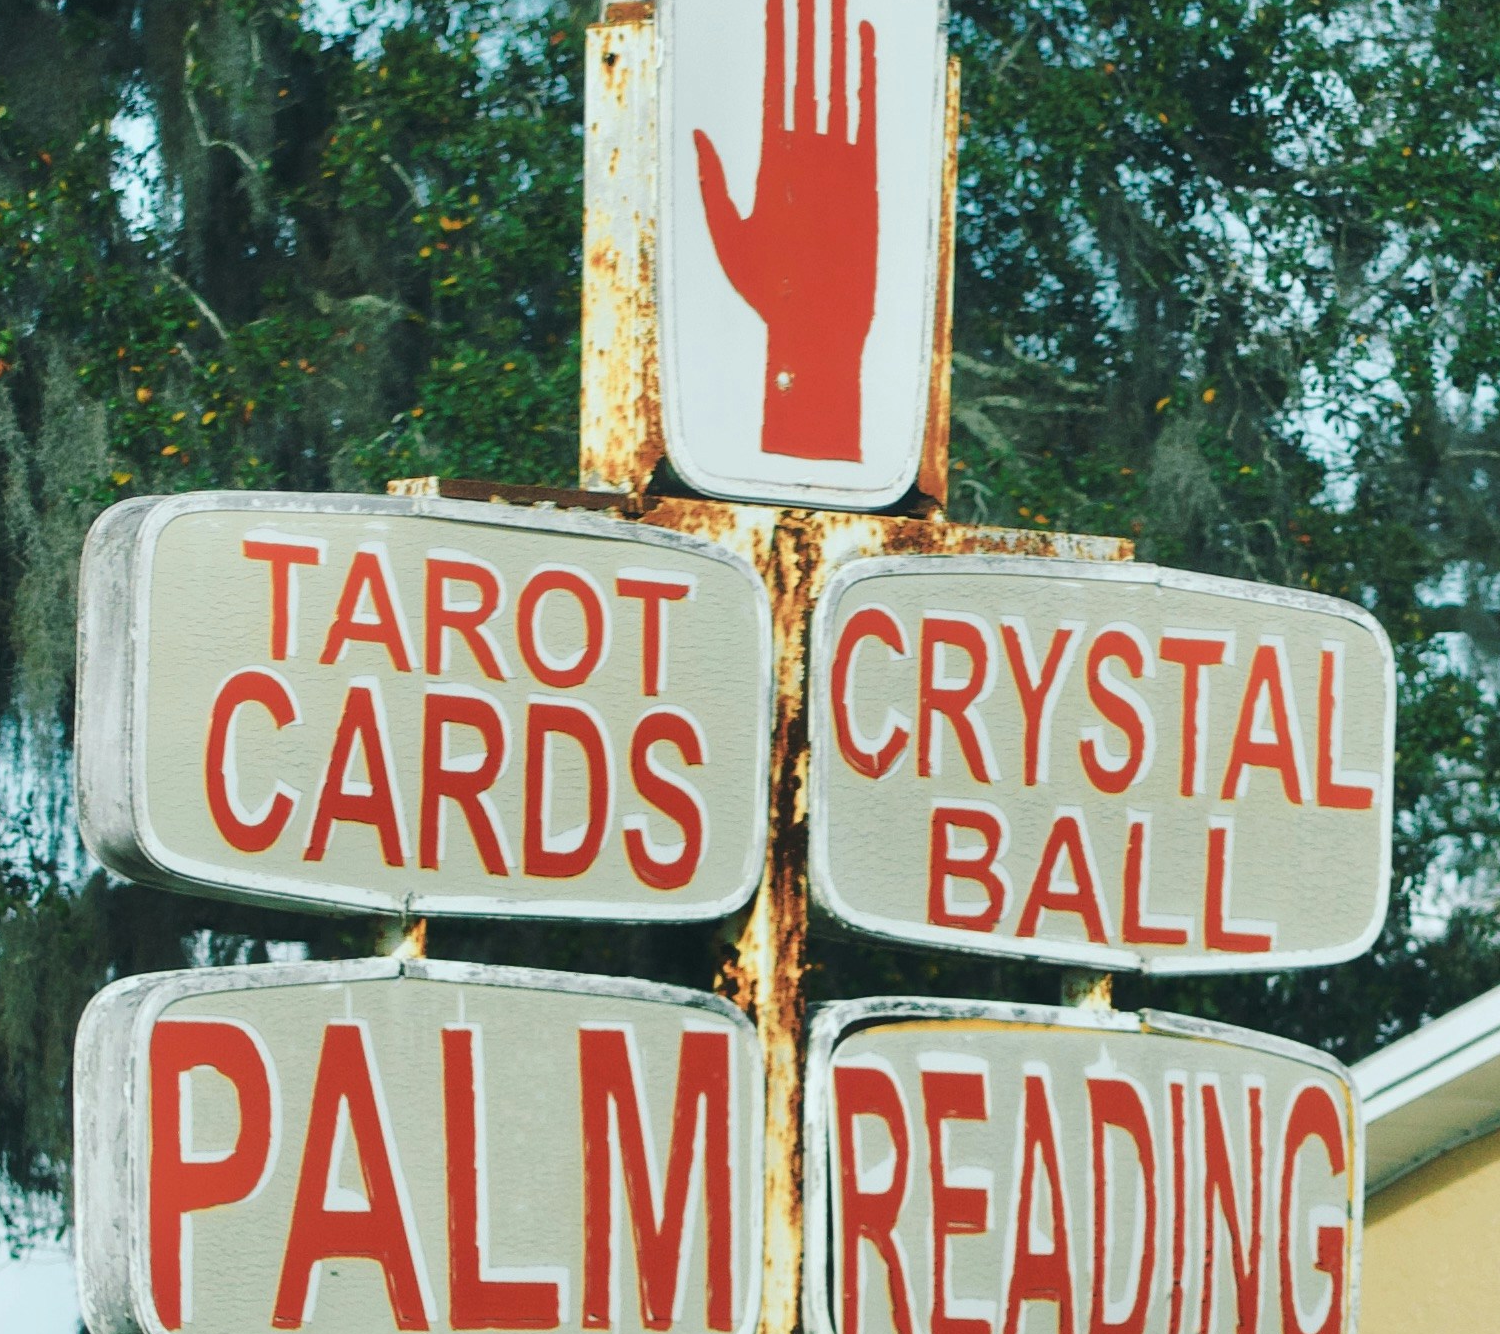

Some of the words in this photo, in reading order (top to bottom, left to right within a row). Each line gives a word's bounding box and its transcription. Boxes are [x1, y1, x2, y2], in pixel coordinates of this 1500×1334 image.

[242, 539, 691, 698] TAROT
[830, 607, 1376, 812] CRYSTAL
[204, 670, 705, 891] CARDS
[928, 807, 1274, 954] BALL
[148, 1020, 734, 1333] PALM
